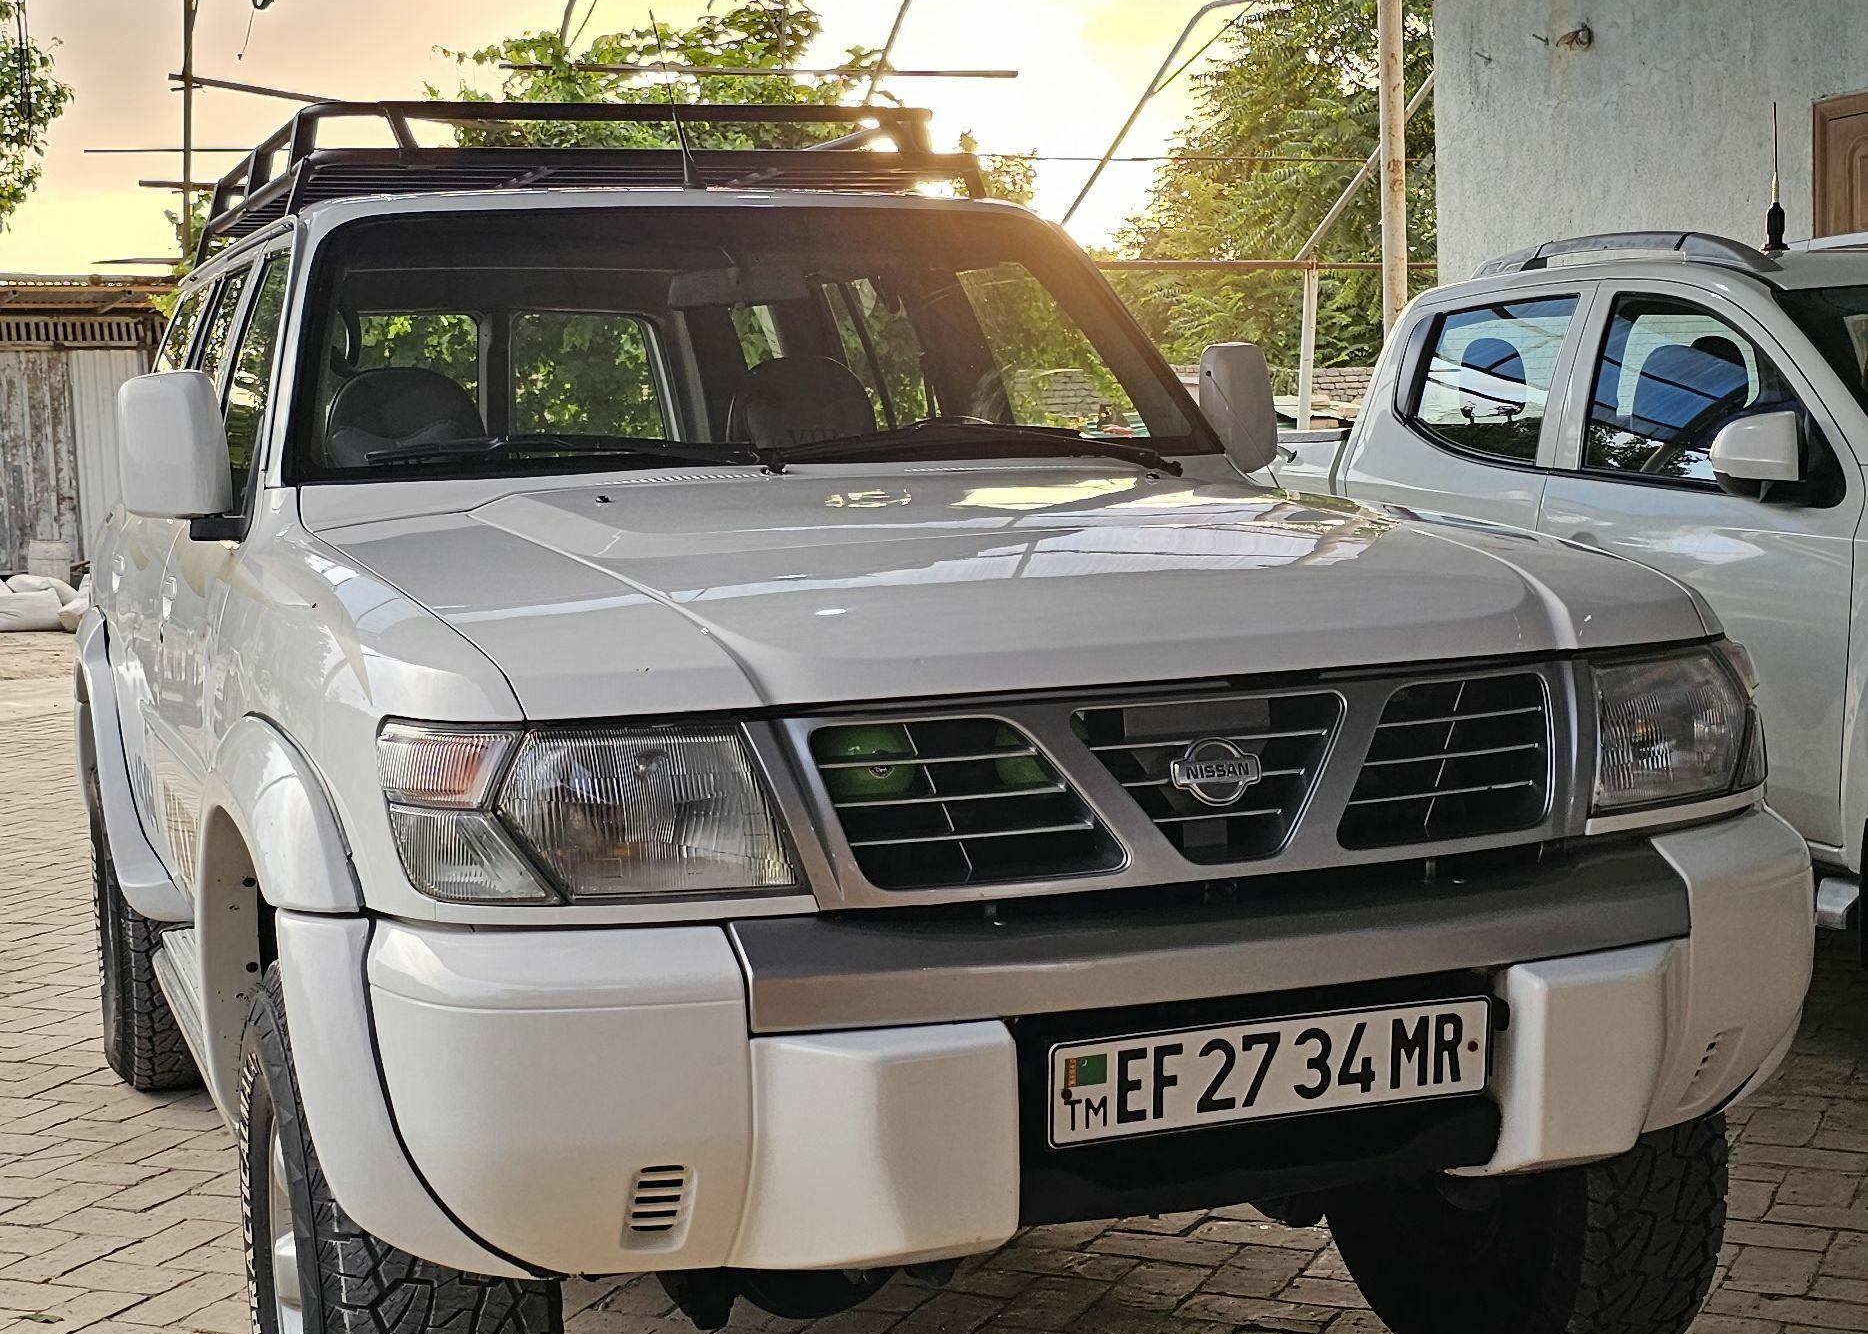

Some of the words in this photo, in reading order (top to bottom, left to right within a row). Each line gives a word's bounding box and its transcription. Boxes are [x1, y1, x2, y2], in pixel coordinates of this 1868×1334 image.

[1186, 762, 1249, 780] NISSAN
[1116, 1042, 1184, 1125] EF
[1196, 1031, 1281, 1114] 27
[1293, 1021, 1376, 1100] 34
[1389, 1012, 1464, 1090] MR
[1063, 1095, 1108, 1132] TM
